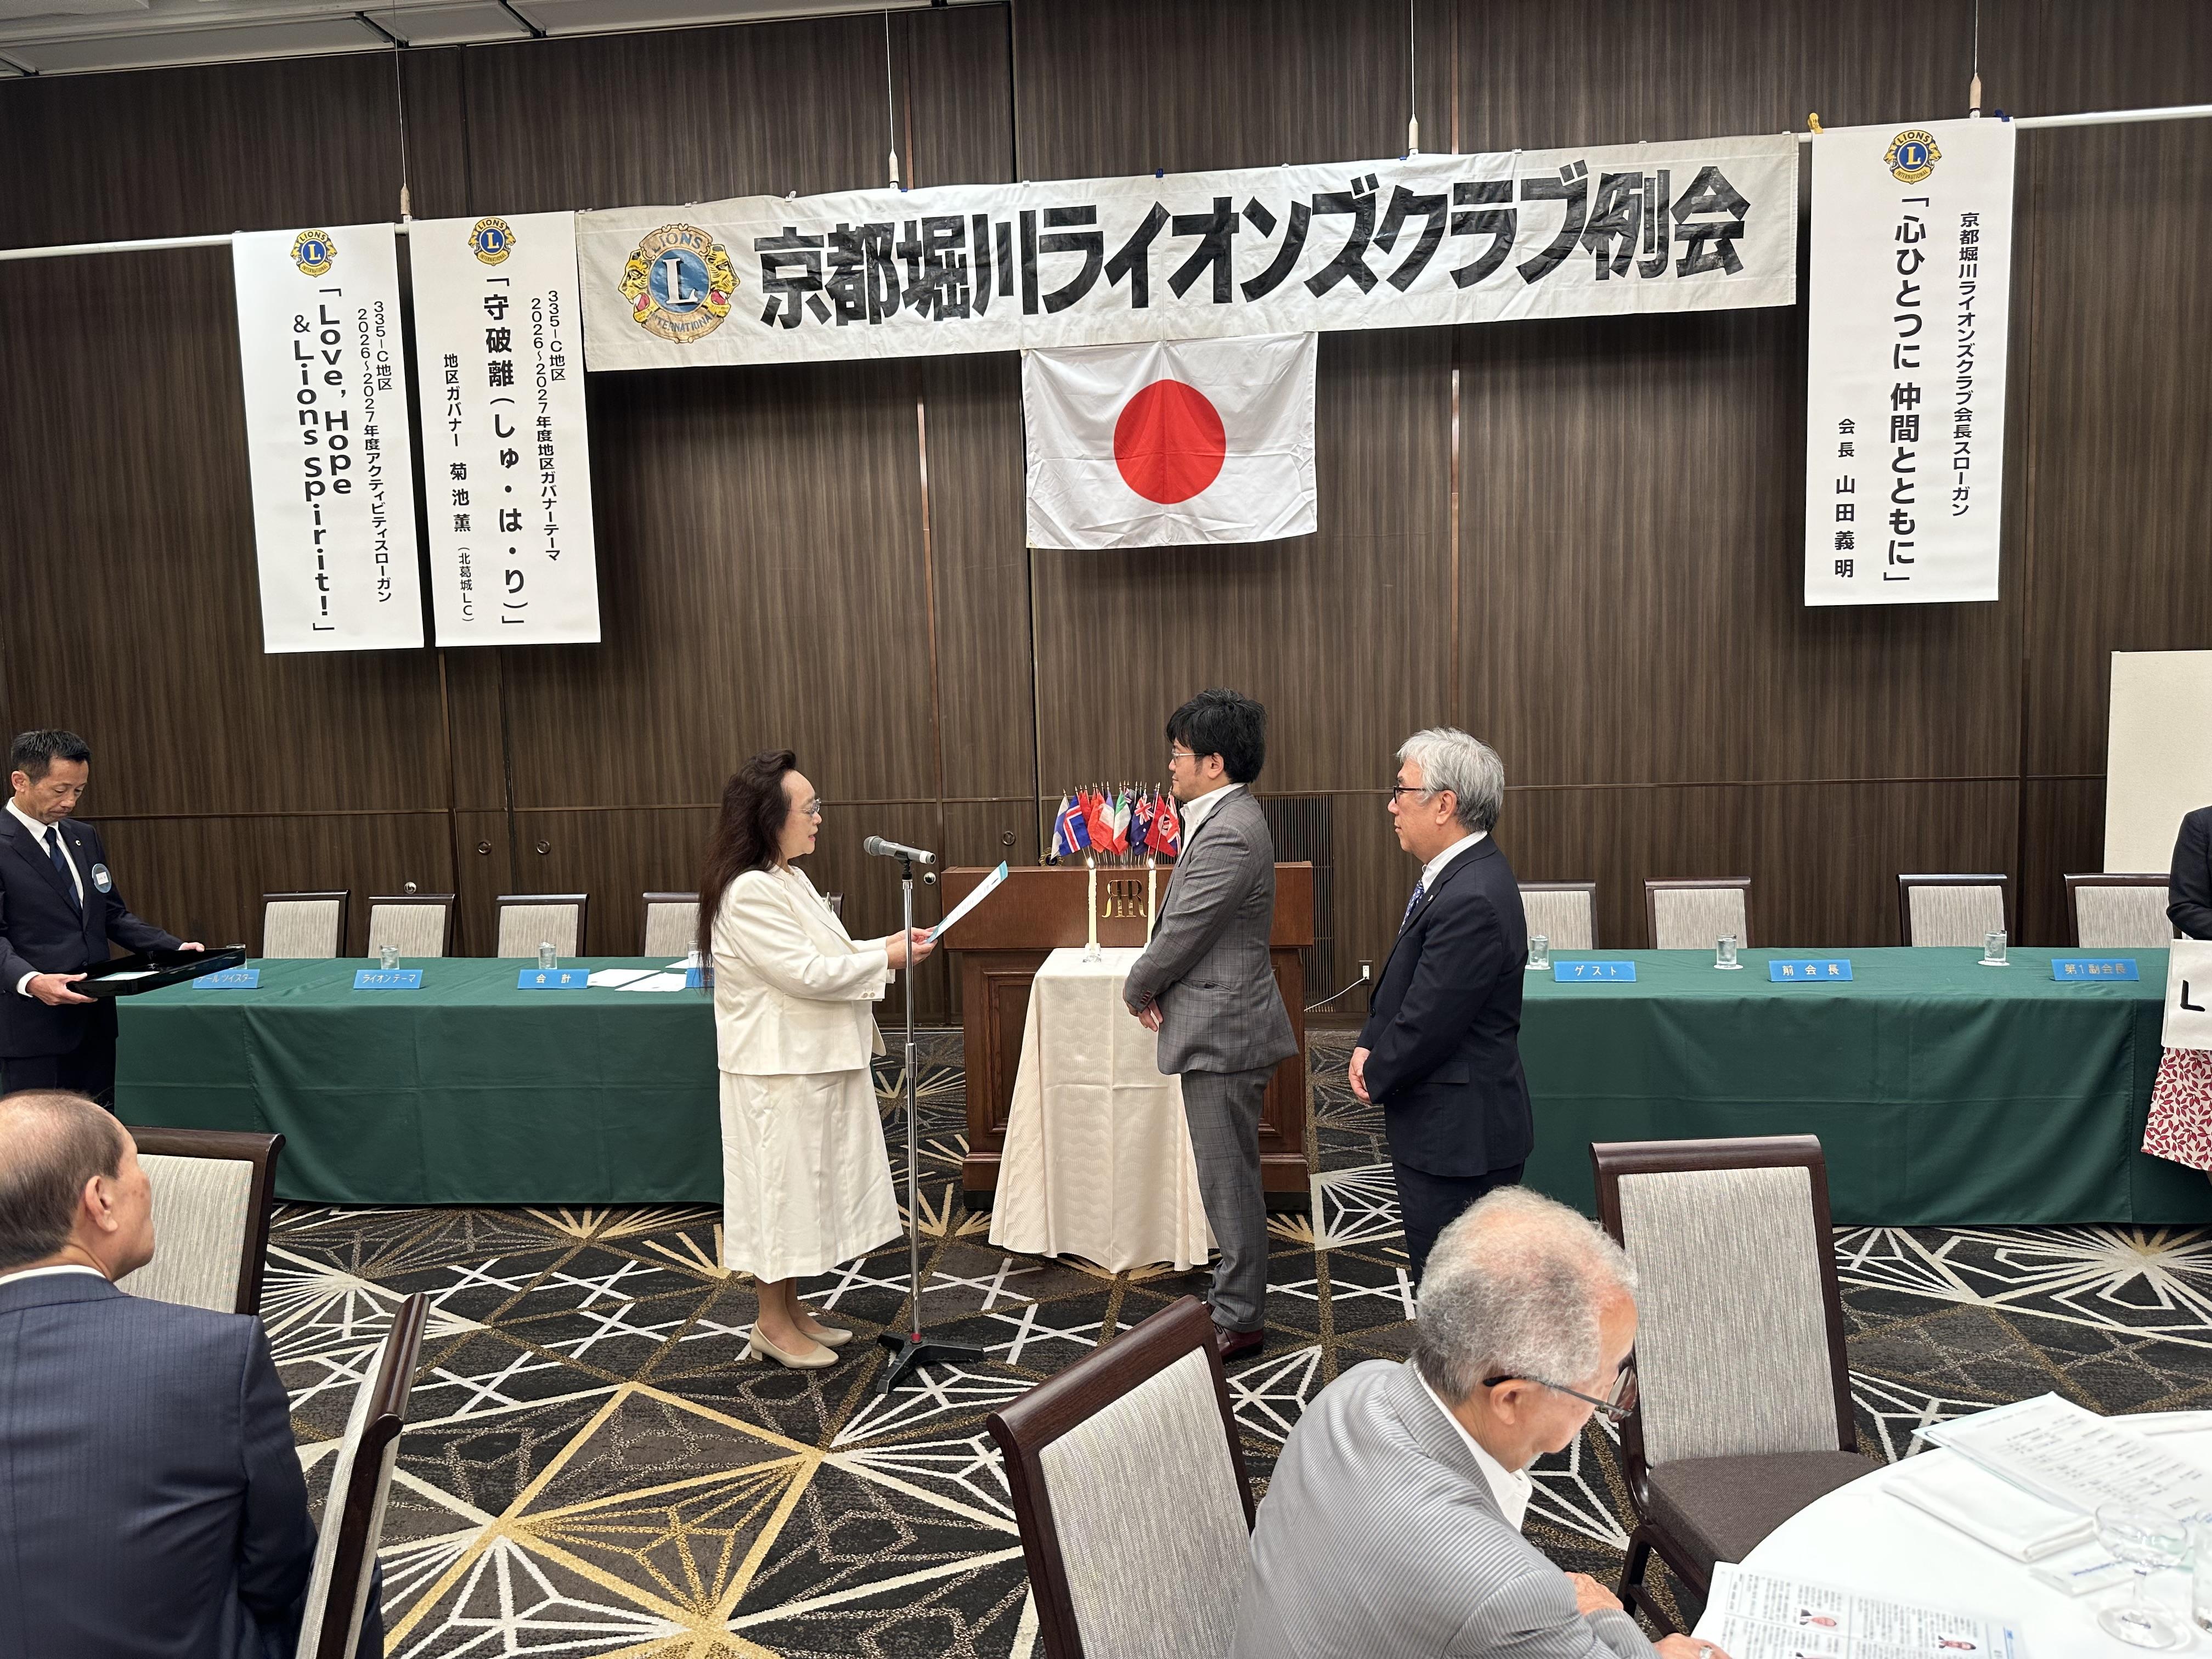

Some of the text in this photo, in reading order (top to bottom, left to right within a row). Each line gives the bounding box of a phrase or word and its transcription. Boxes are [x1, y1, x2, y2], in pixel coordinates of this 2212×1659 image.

[1897, 132, 1930, 144] LIONS
[1906, 146, 1921, 165] L
[477, 219, 505, 230] LIONS
[300, 232, 326, 241] LIONS
[487, 232, 500, 249] L
[754, 160, 1751, 330] 京都堀川ライオンズクラブ例会
[308, 244, 321, 261] L
[663, 258, 698, 304] L
[294, 314, 311, 333] &
[1953, 212, 1979, 516] 京都堀川ライオンズクラブ会長スローガン
[294, 340, 318, 445] Lions
[443, 353, 462, 447] 地区ガバナー
[325, 410, 352, 494] Hope
[450, 462, 471, 532] 菊池薫
[1835, 418, 1855, 578] 会長 山田義明
[536, 973, 572, 984] 会計
[1575, 964, 1617, 976] ゲスト
[1782, 964, 1839, 976] 前会長
[2180, 980, 2205, 1012] L
